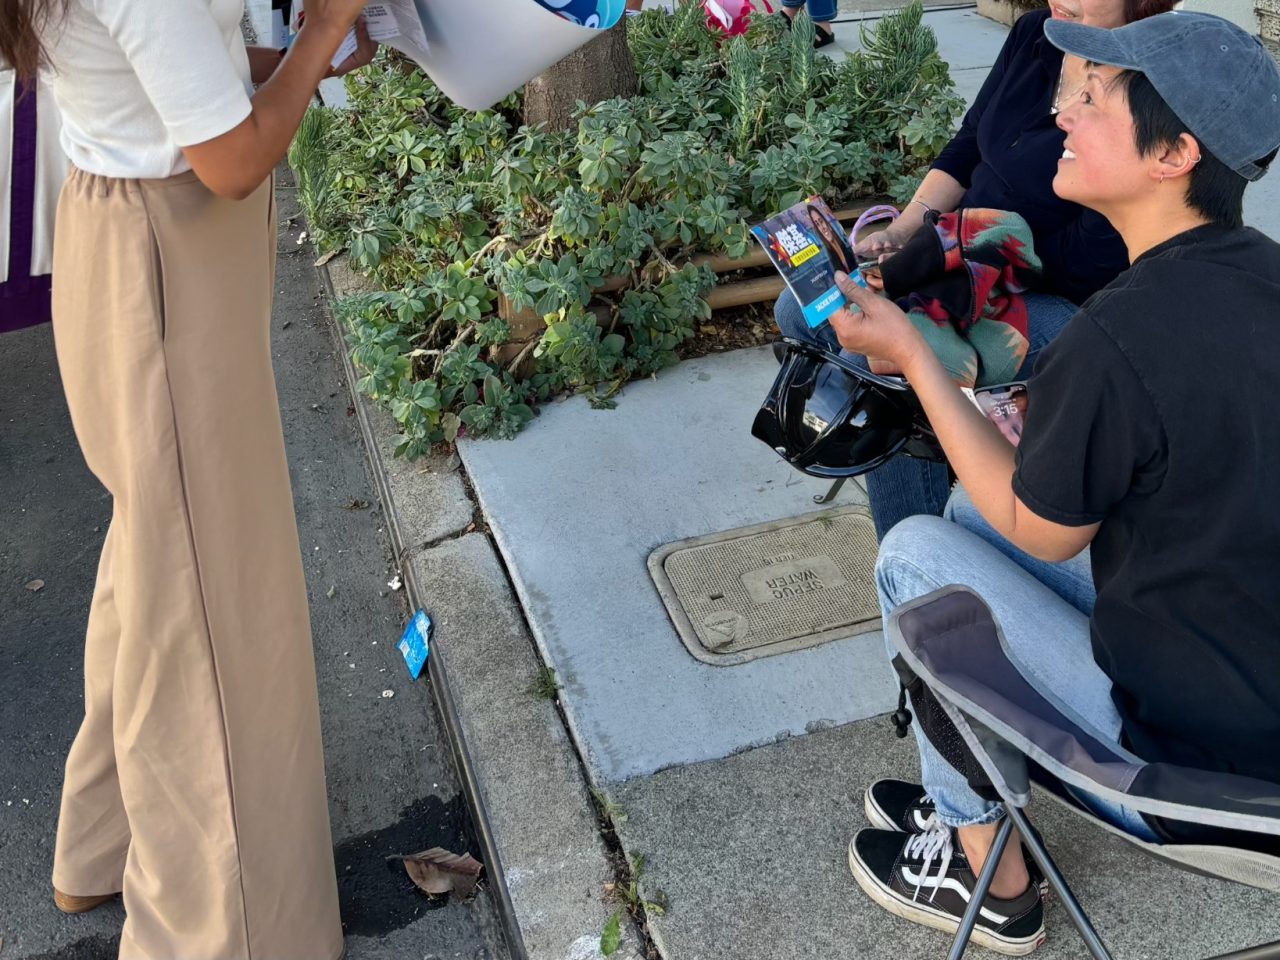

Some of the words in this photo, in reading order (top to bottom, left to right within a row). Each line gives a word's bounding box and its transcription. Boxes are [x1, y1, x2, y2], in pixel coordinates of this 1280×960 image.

[993, 403, 1018, 417] 3:15
[765, 569, 818, 589] WATER
[773, 580, 824, 599] SFPUC
